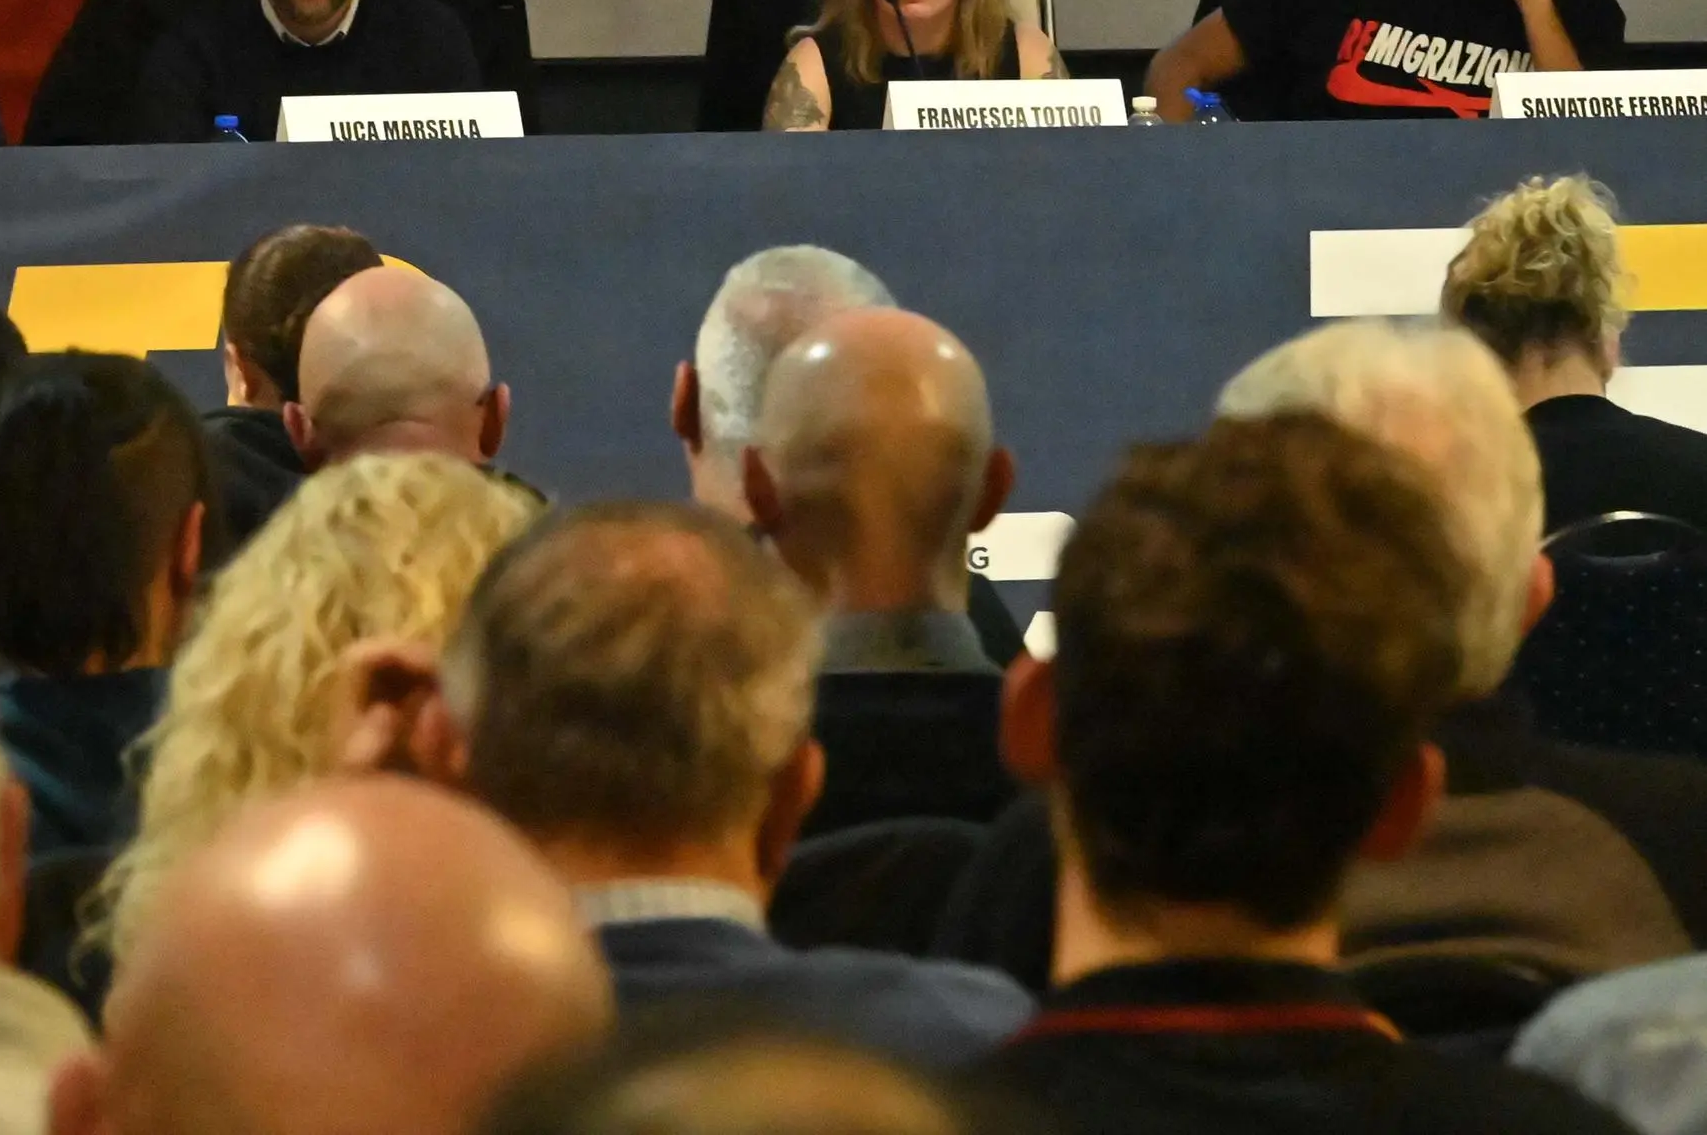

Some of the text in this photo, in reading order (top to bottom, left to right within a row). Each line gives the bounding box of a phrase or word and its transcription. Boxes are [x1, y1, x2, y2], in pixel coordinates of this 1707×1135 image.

[1336, 17, 1535, 89] REMIGRAZION
[917, 105, 1102, 129] FRANCESCA TOTOLO
[1521, 97, 1625, 118] SALVATORE
[329, 118, 482, 142] LUCA MARSELLA
